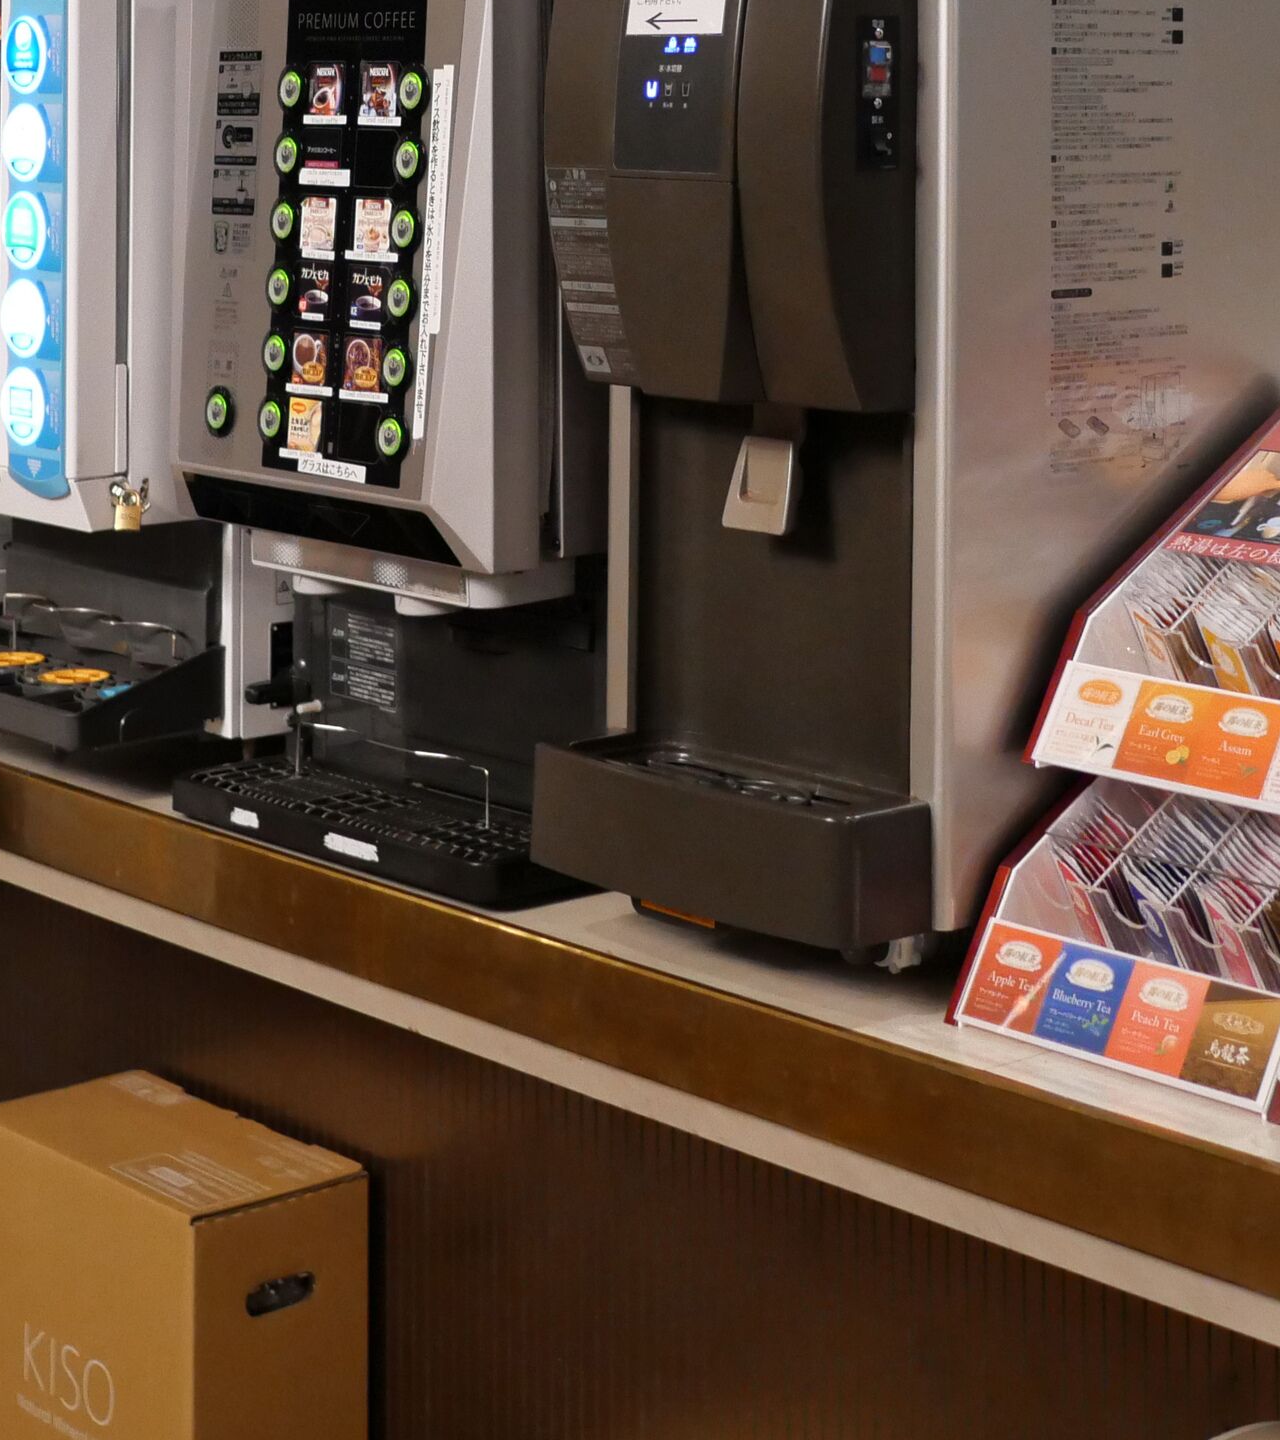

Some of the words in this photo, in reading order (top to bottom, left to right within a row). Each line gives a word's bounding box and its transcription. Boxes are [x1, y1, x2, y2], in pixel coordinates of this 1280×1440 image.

[297, 12, 359, 30] PREMIUM
[364, 11, 416, 29] COFFEE
[301, 263, 329, 280] カフェモカ
[352, 269, 382, 285] カフェモカ
[301, 461, 358, 479] グラスはこちらへ
[1065, 711, 1096, 729] Decaf
[1098, 719, 1115, 733] Tea
[1138, 724, 1160, 739] Earl
[1161, 729, 1186, 744] Grey
[1218, 740, 1252, 757] Assam
[987, 970, 1016, 988] Apple
[1018, 976, 1037, 993] Tea
[1052, 988, 1095, 1010] Blueberry
[1096, 999, 1112, 1015] Tea
[1130, 1010, 1161, 1028] Peach
[1163, 1017, 1180, 1034] Tea
[1205, 1038, 1251, 1066] 烏龍茶
[23, 1321, 115, 1426] KISO
